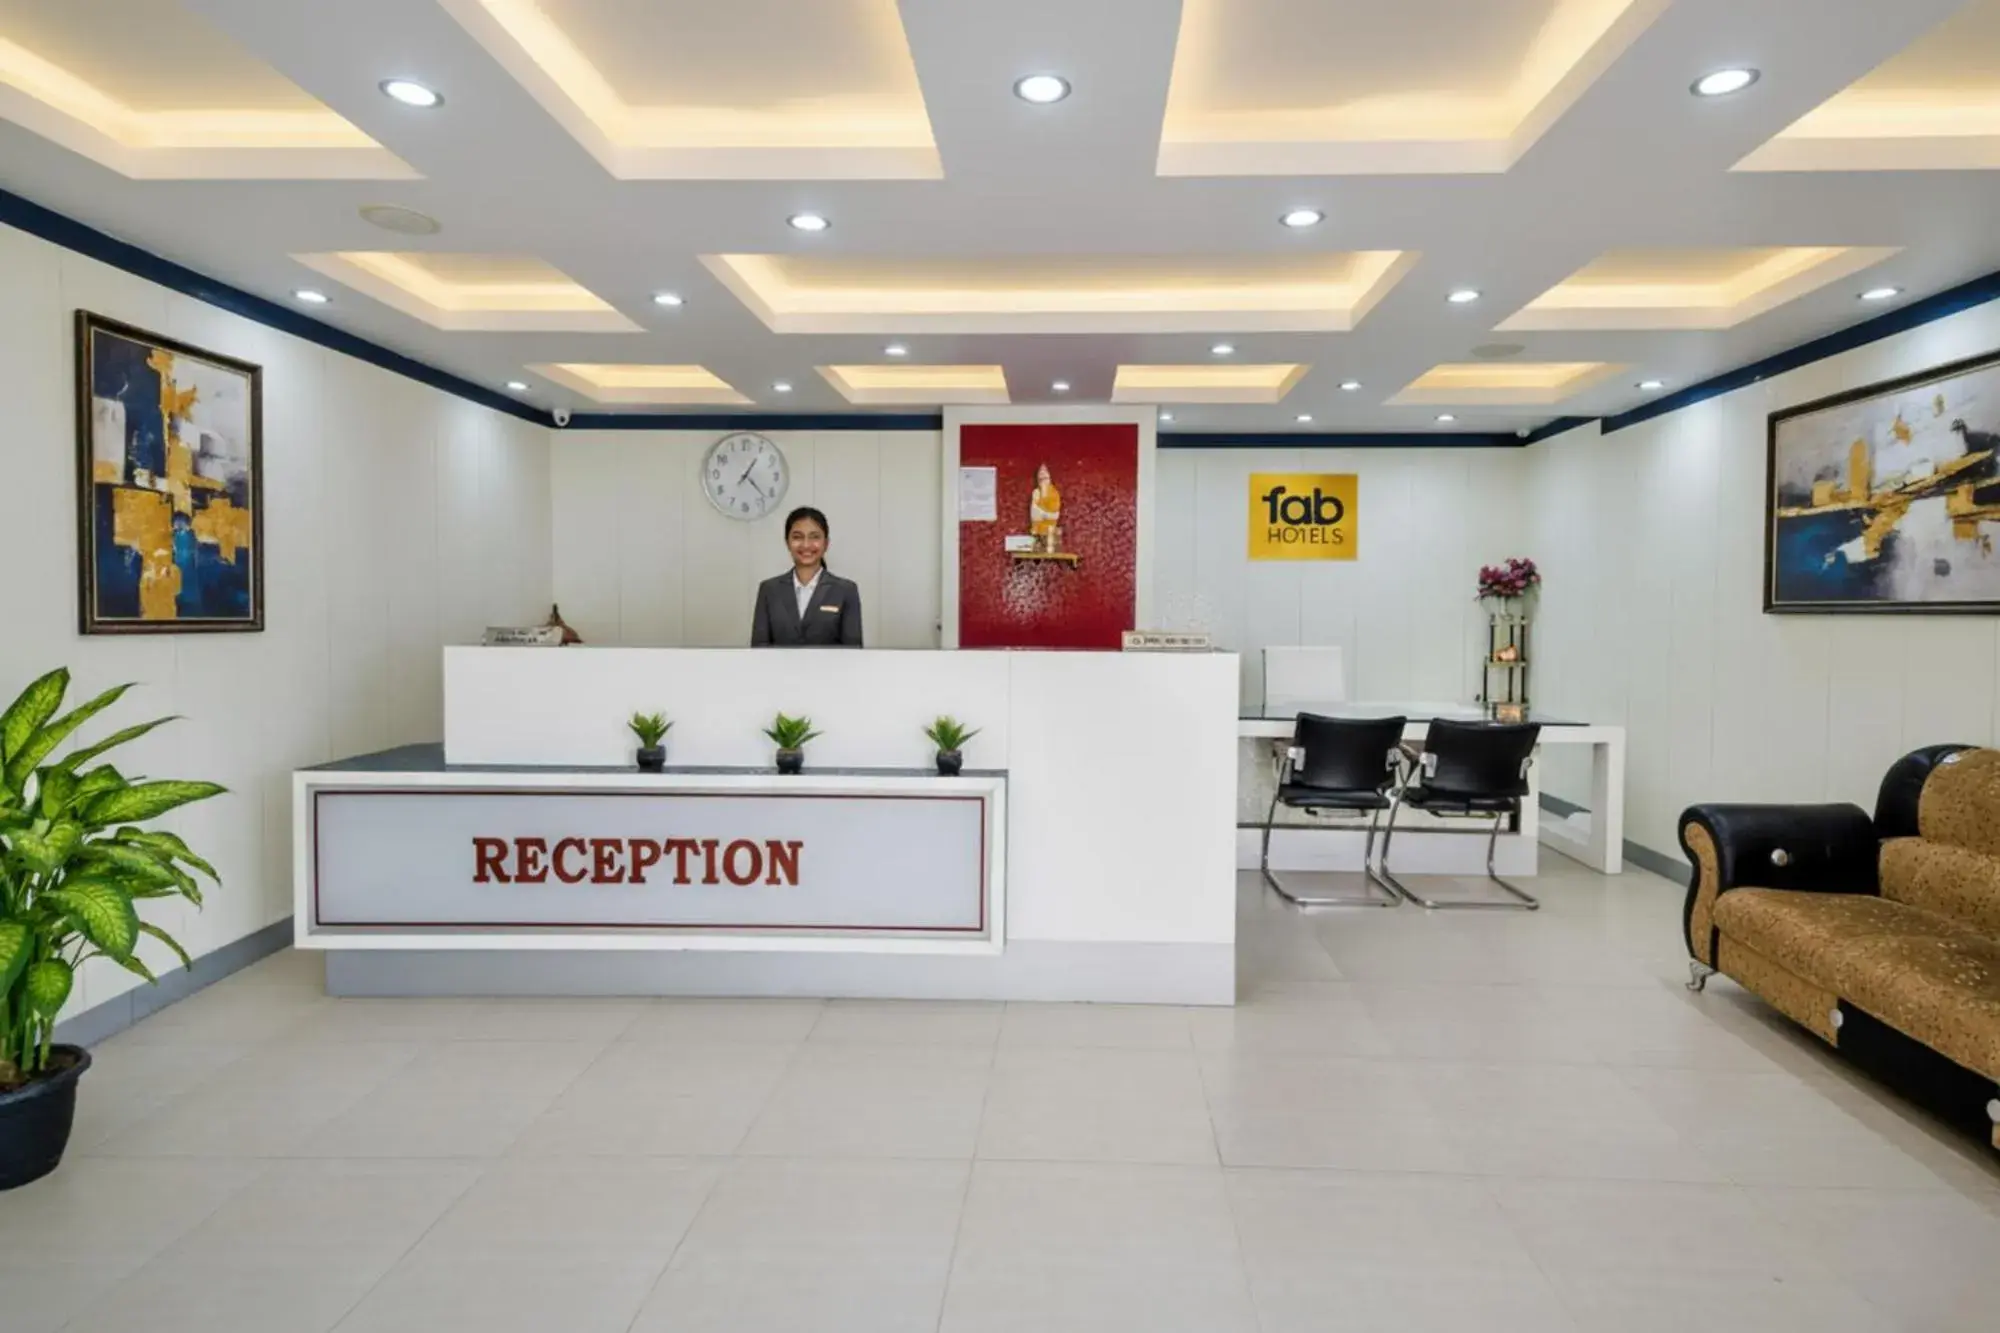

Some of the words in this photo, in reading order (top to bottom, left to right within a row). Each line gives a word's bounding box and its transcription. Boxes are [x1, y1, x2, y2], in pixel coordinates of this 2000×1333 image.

[1261, 485, 1344, 526] fab
[1267, 527, 1344, 545] HOTELS
[472, 836, 804, 886] RECEPTION
